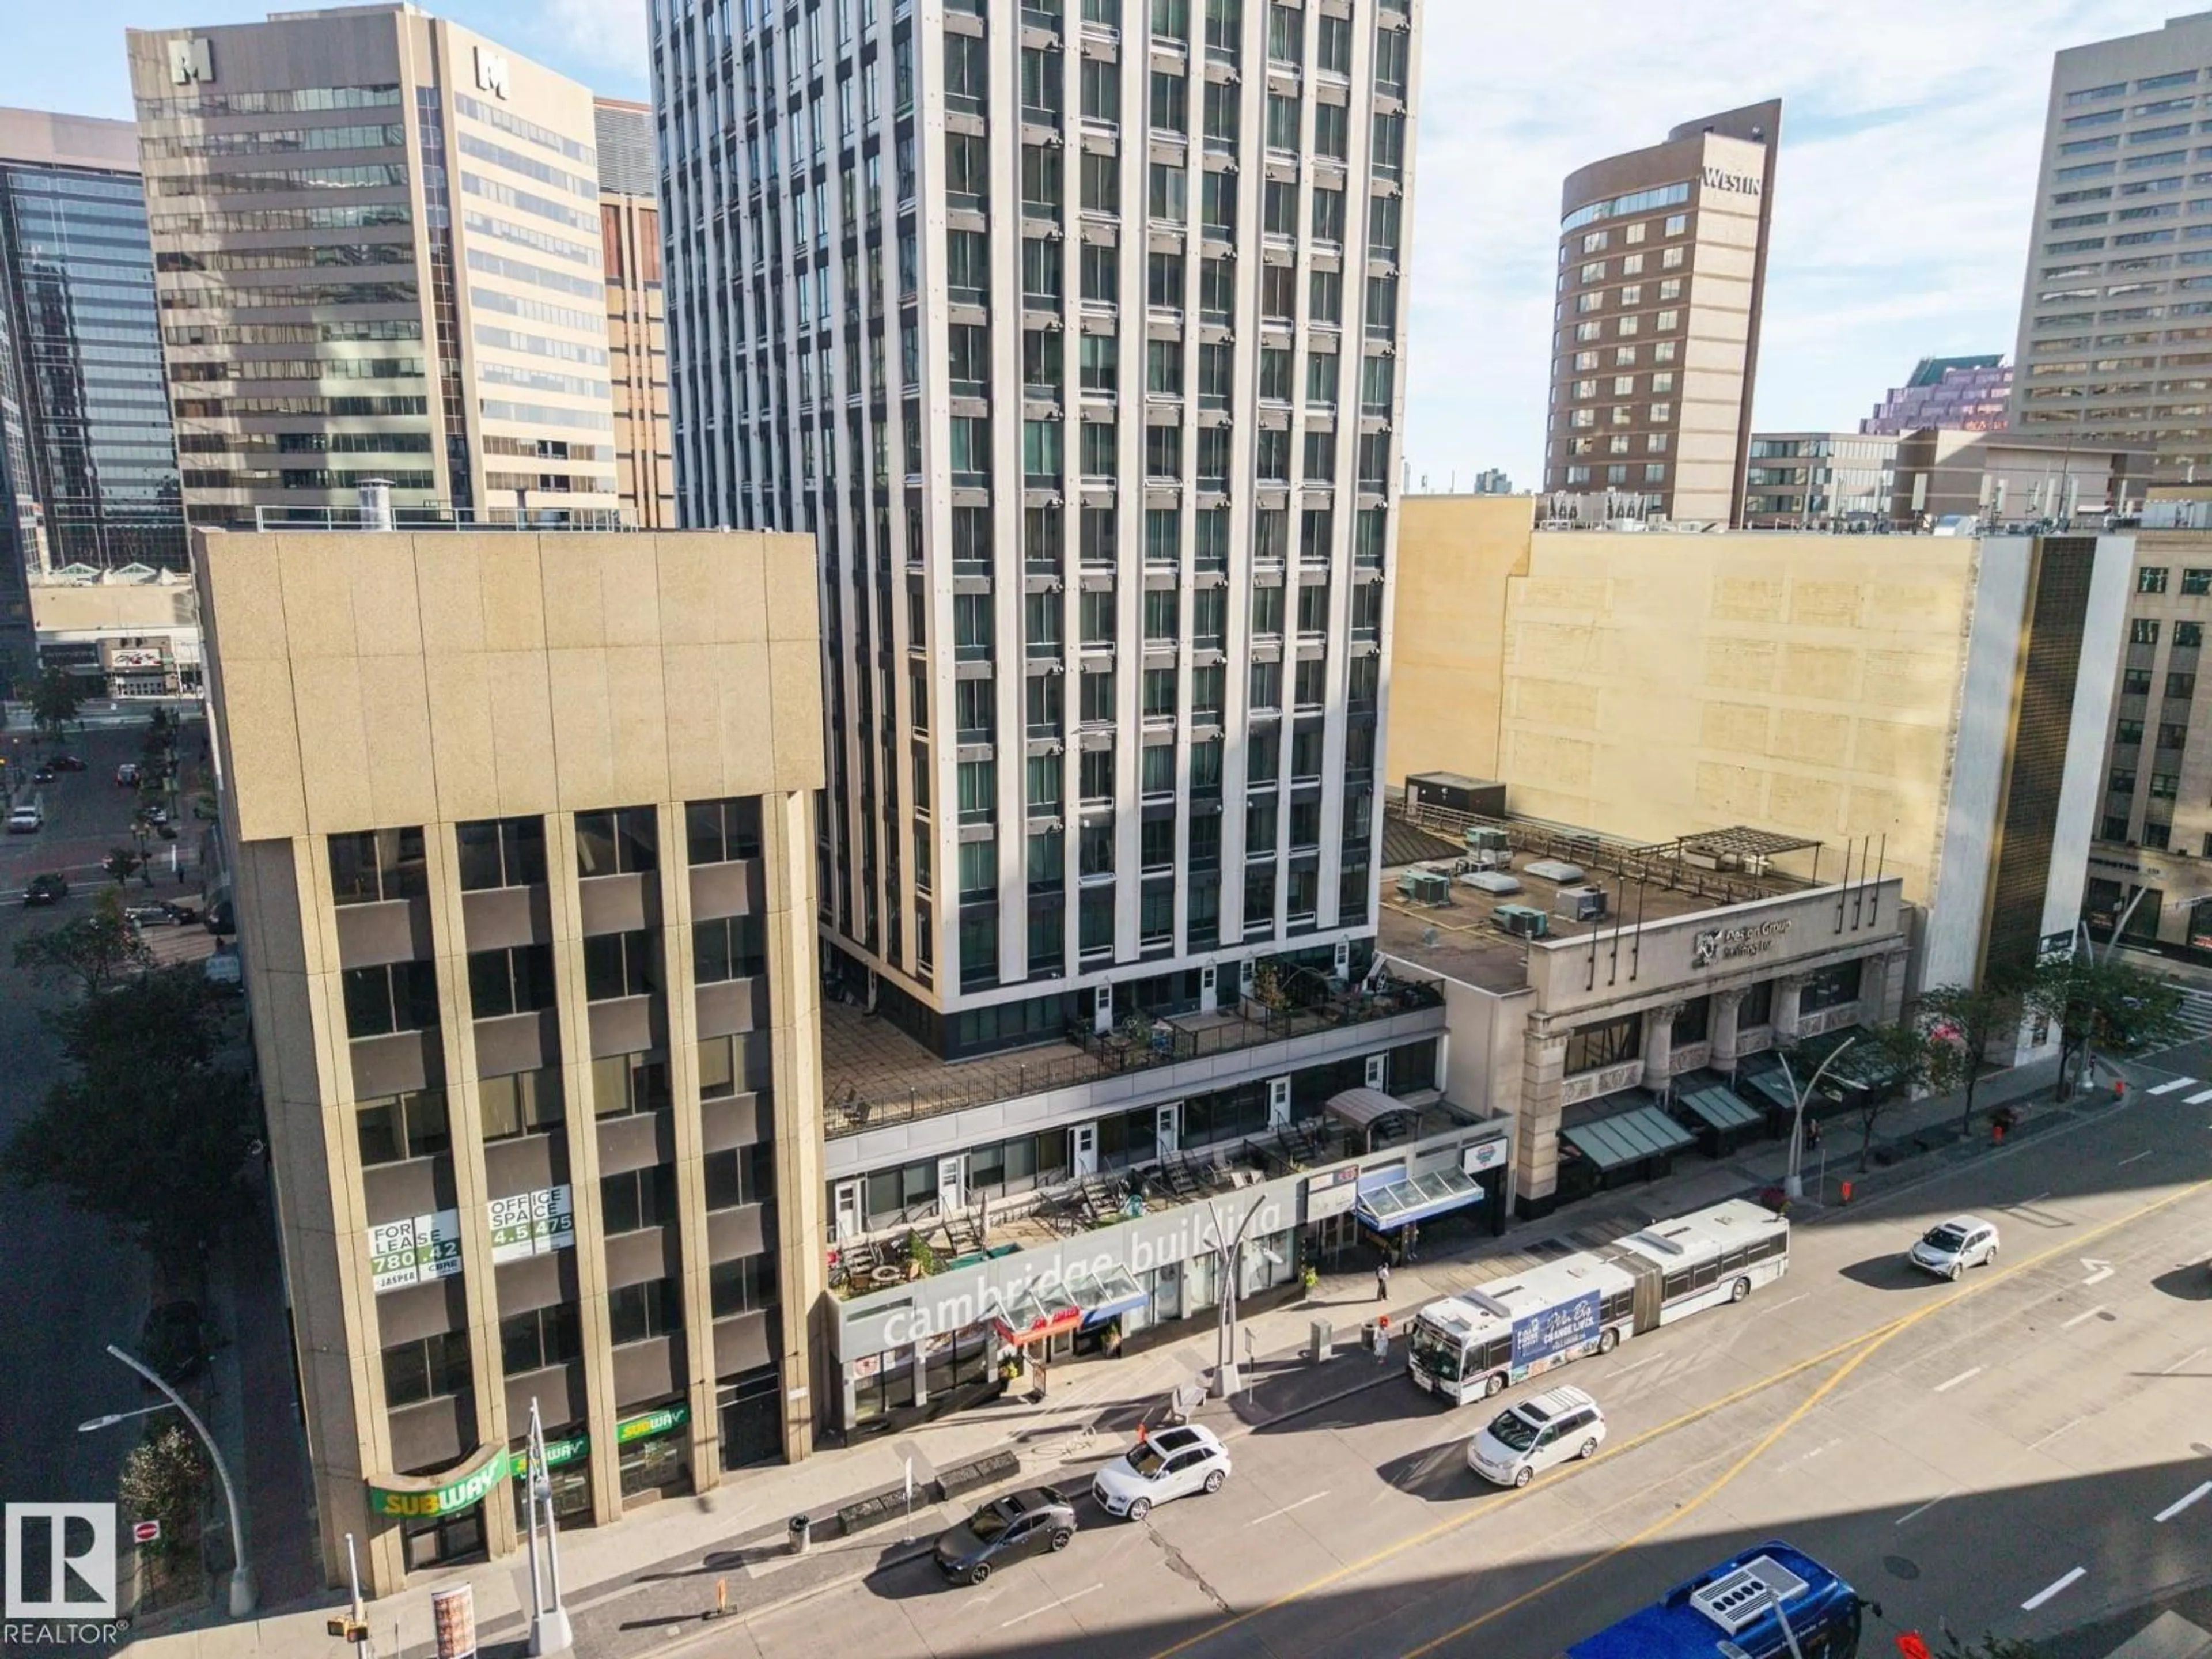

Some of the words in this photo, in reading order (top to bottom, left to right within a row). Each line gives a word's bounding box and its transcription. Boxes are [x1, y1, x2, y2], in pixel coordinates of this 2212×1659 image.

[168, 38, 213, 82] M
[476, 47, 509, 98] M
[1701, 166, 1762, 194] WESTIN
[491, 1188, 562, 1214] OFFICE
[493, 1203, 558, 1228] SPACE
[374, 1223, 411, 1241] FOR
[376, 1229, 441, 1255] LEASE
[884, 1251, 1120, 1347] cambridge
[1131, 1203, 1280, 1266] building
[621, 1410, 684, 1438] SUBWAY
[383, 1459, 499, 1515] SUBWAY
